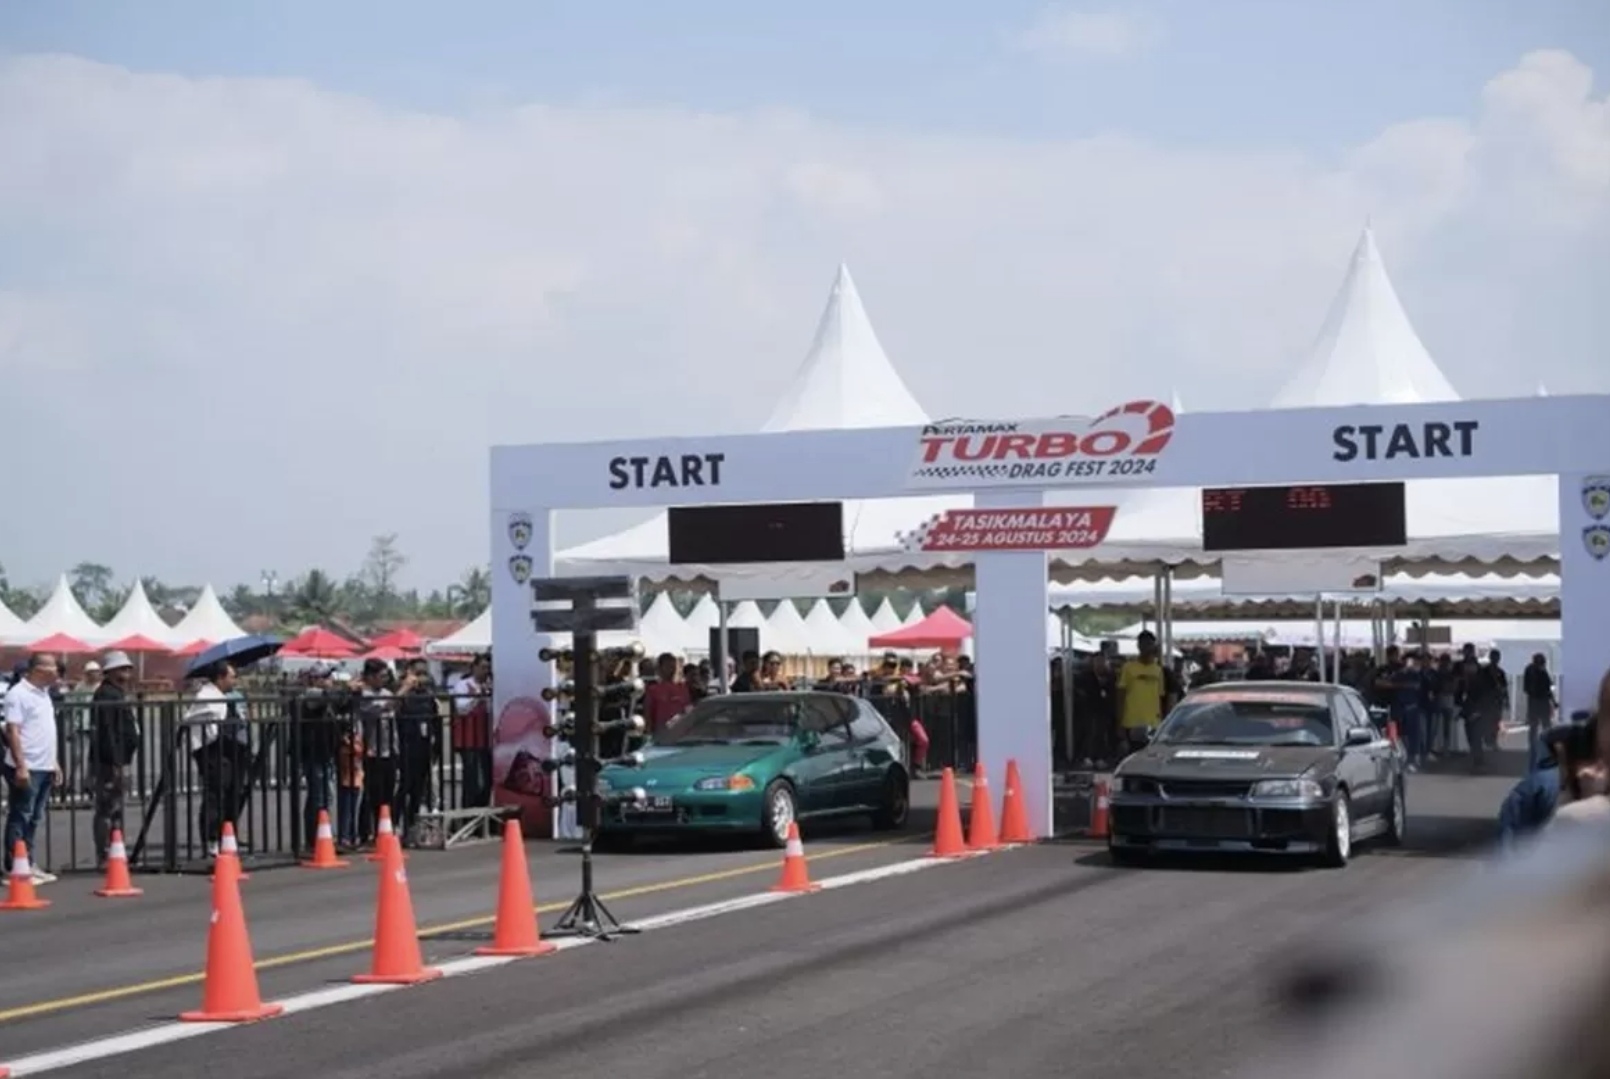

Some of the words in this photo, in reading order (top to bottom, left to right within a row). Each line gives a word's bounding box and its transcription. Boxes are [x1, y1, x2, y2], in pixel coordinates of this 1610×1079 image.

[922, 424, 1018, 435] PERTAMAX
[919, 431, 1132, 463] TURBO
[1332, 421, 1479, 462] START
[608, 453, 725, 490] START
[1008, 462, 1062, 479] DRAG
[1065, 460, 1107, 477] FEST
[1108, 458, 1158, 475] 2024
[952, 511, 1092, 531] TASIKMALAYA
[935, 532, 980, 546] 24-25
[980, 531, 1054, 546] AGUSTUS
[1057, 530, 1098, 544] 2024
